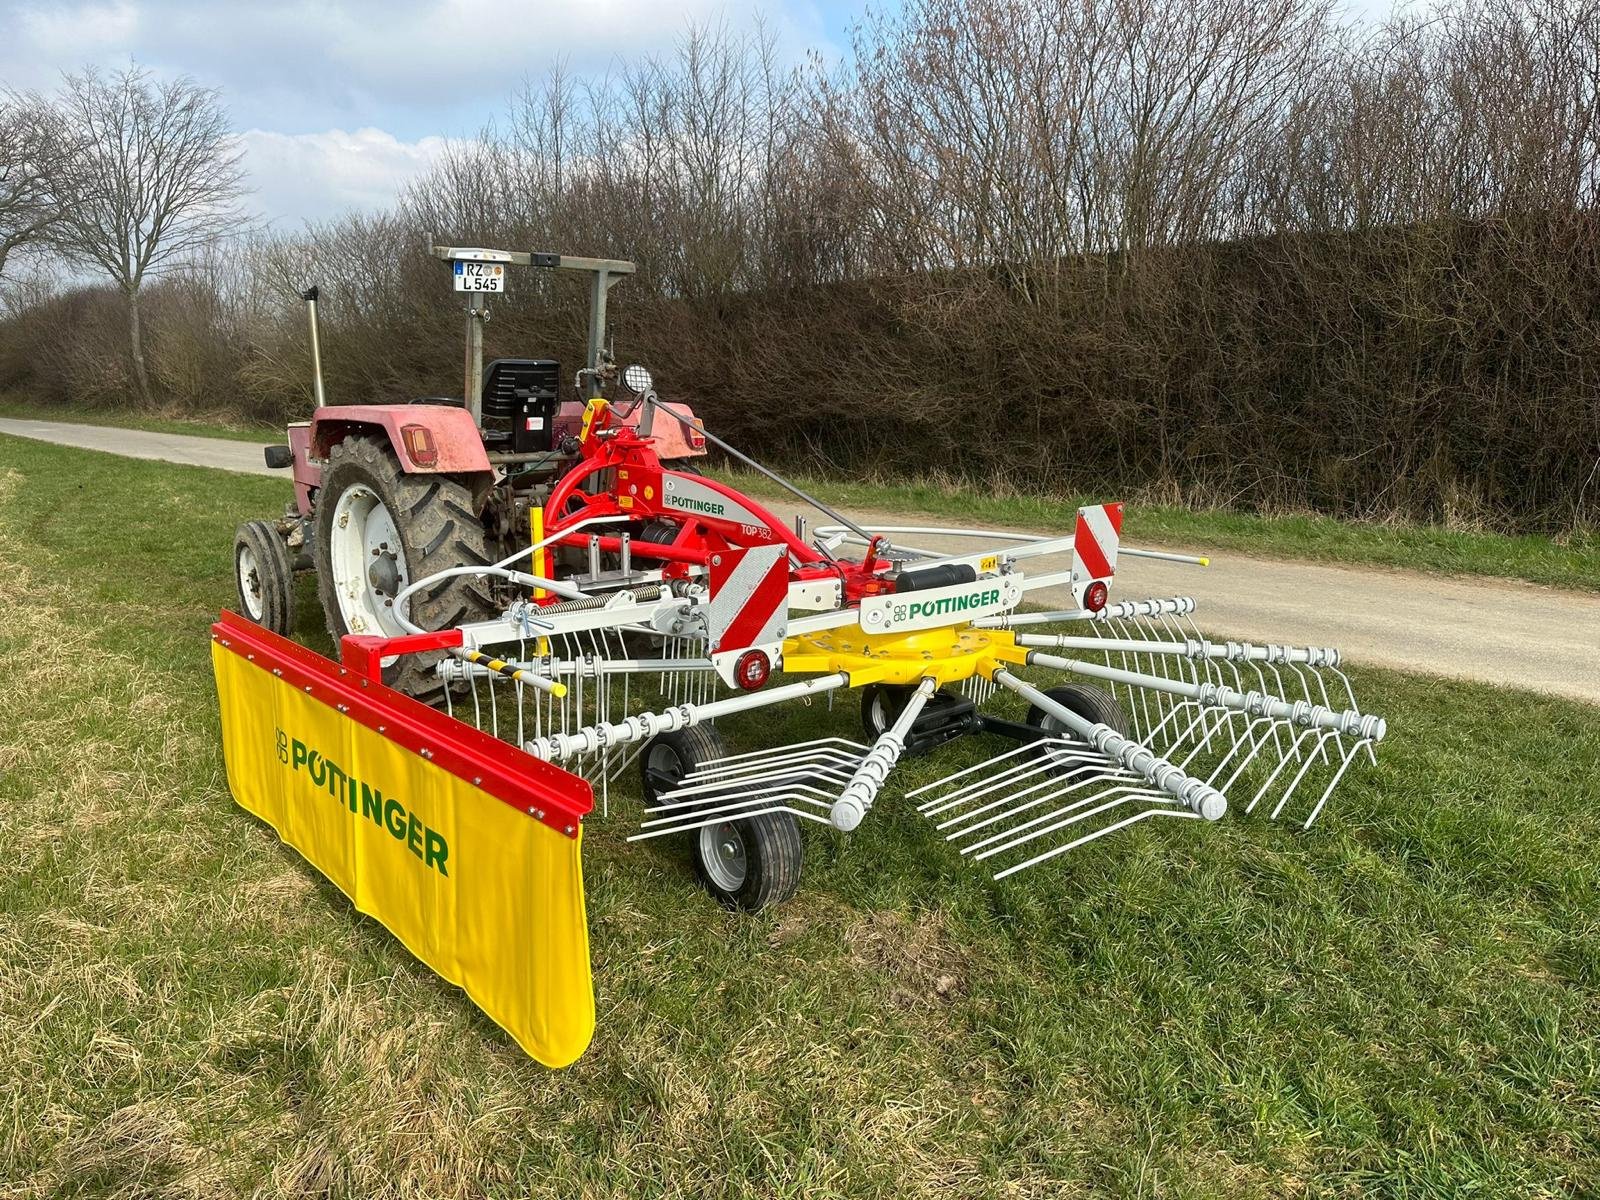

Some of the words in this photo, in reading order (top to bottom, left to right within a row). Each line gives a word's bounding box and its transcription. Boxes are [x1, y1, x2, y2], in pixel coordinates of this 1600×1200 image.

[467, 263, 483, 277] RZ
[463, 277, 472, 290] L
[474, 277, 498, 291] 545
[741, 524, 757, 537] TOP
[758, 528, 772, 540] 382
